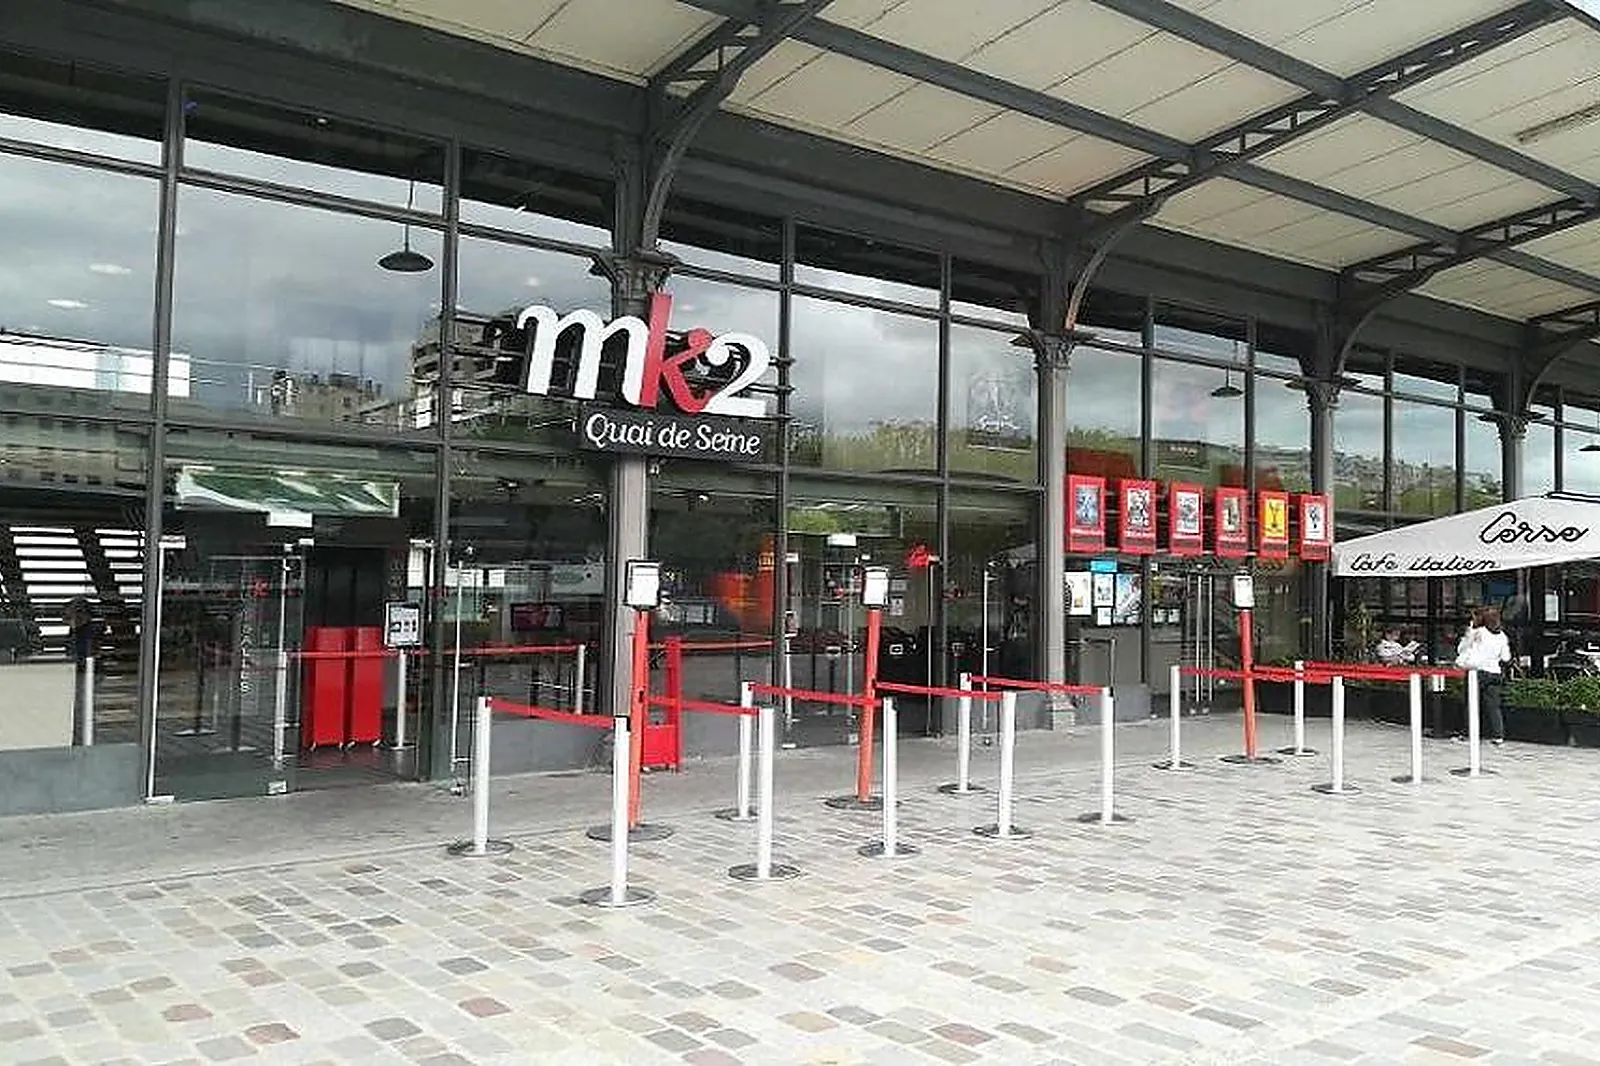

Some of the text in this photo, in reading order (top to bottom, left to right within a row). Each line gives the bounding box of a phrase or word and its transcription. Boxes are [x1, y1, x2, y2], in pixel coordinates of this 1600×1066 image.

[517, 290, 770, 417] mk2
[585, 413, 761, 455] Quai de Seine
[1408, 554, 1500, 572] italien
